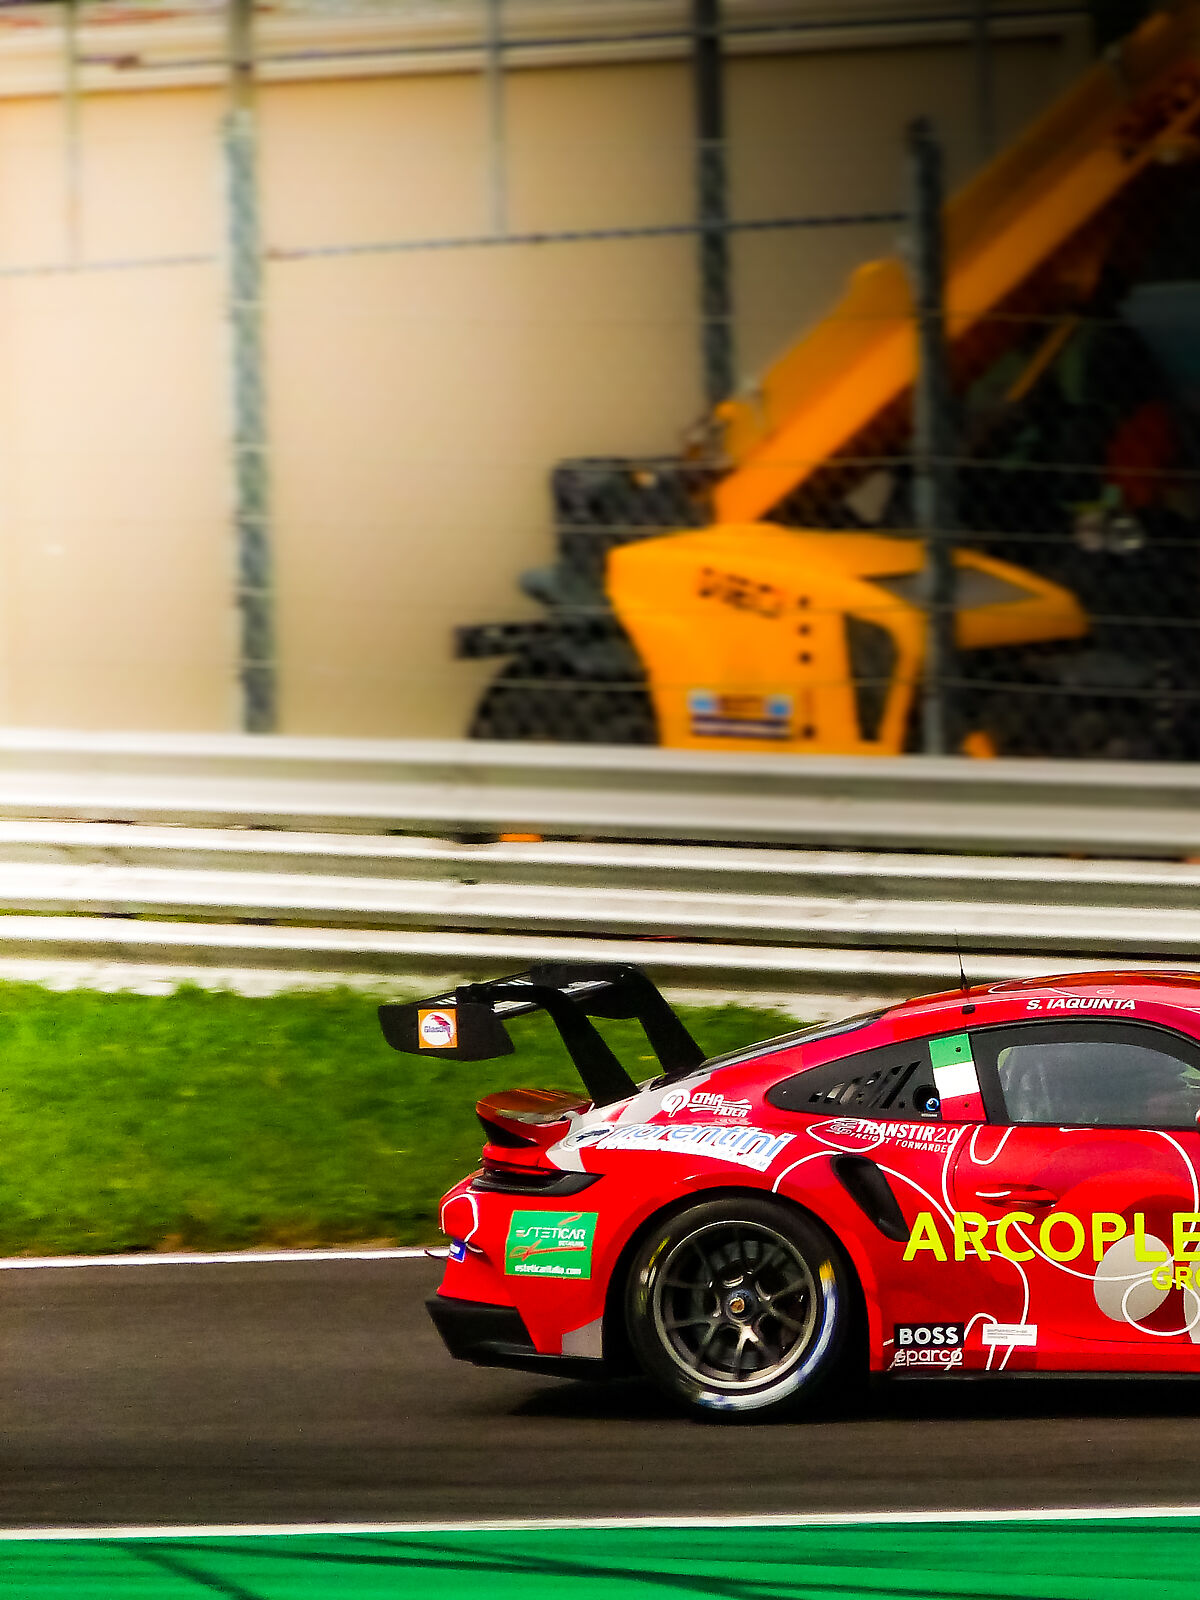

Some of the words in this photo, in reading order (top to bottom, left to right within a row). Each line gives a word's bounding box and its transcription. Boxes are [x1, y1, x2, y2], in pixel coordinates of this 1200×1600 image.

[1026, 1000, 1042, 1010] S.
[1046, 998, 1136, 1010] IAQUINTA
[849, 1131, 892, 1144] FREIGT
[899, 1326, 959, 1345] BOSS
